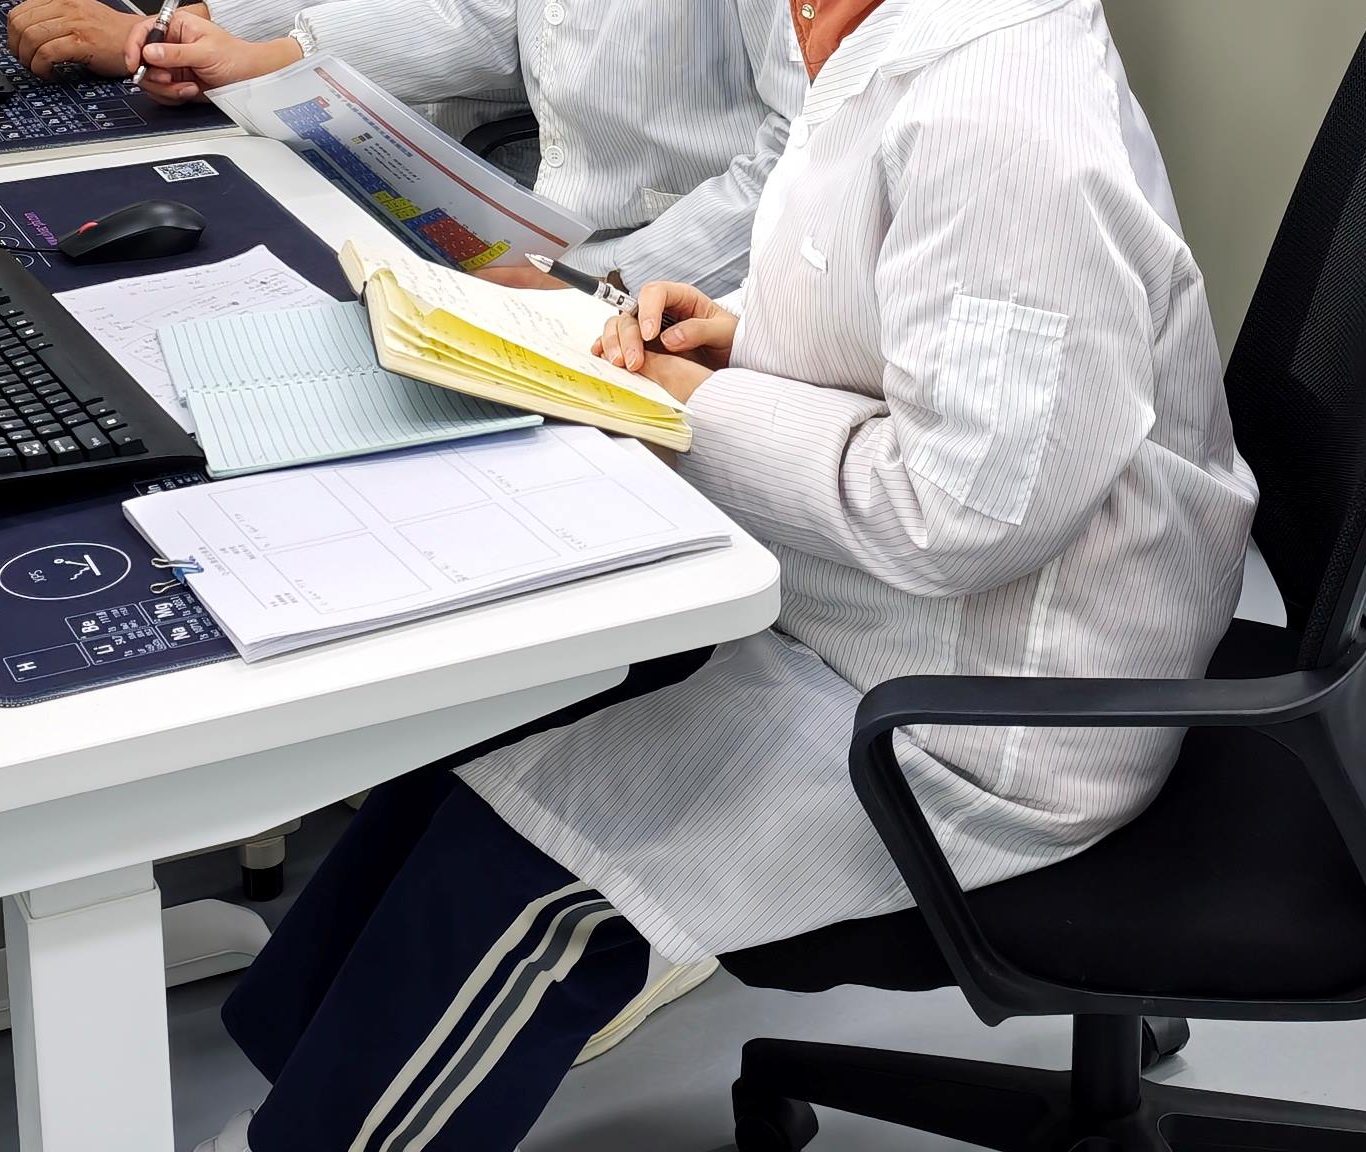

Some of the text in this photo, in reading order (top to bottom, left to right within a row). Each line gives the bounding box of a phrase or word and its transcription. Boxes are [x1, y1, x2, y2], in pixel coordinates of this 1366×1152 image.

[153, 602, 175, 619] Mg
[81, 619, 100, 633] Be
[170, 626, 191, 641] Na
[93, 643, 115, 655] Li
[16, 660, 37, 672] H
